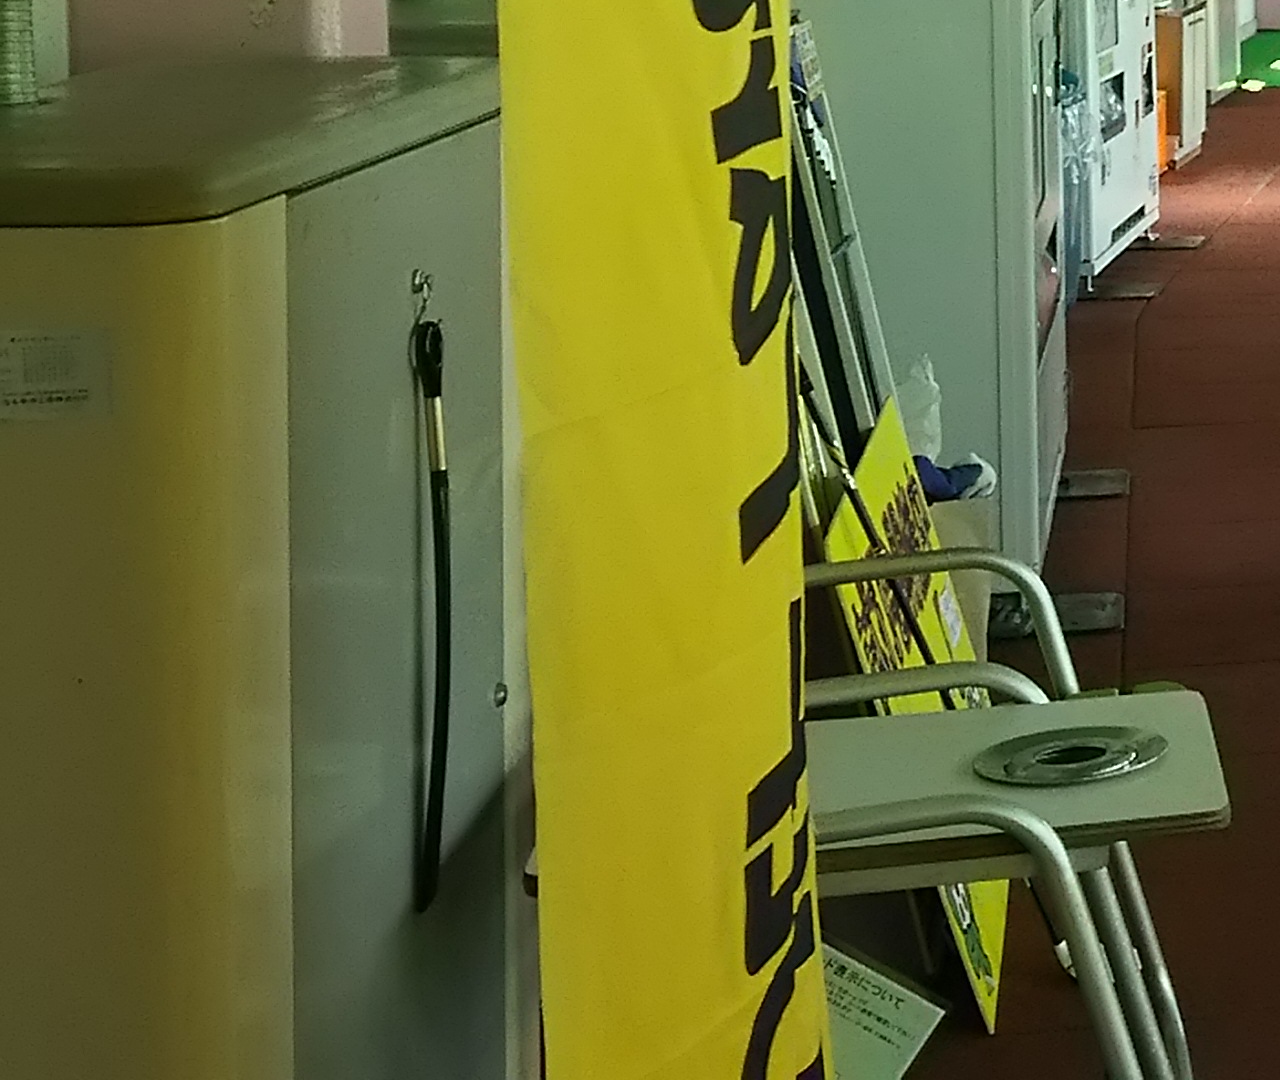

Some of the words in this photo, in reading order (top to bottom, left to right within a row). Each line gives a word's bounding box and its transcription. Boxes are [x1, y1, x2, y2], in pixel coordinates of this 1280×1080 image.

[822, 957, 906, 1010] ド表示について
